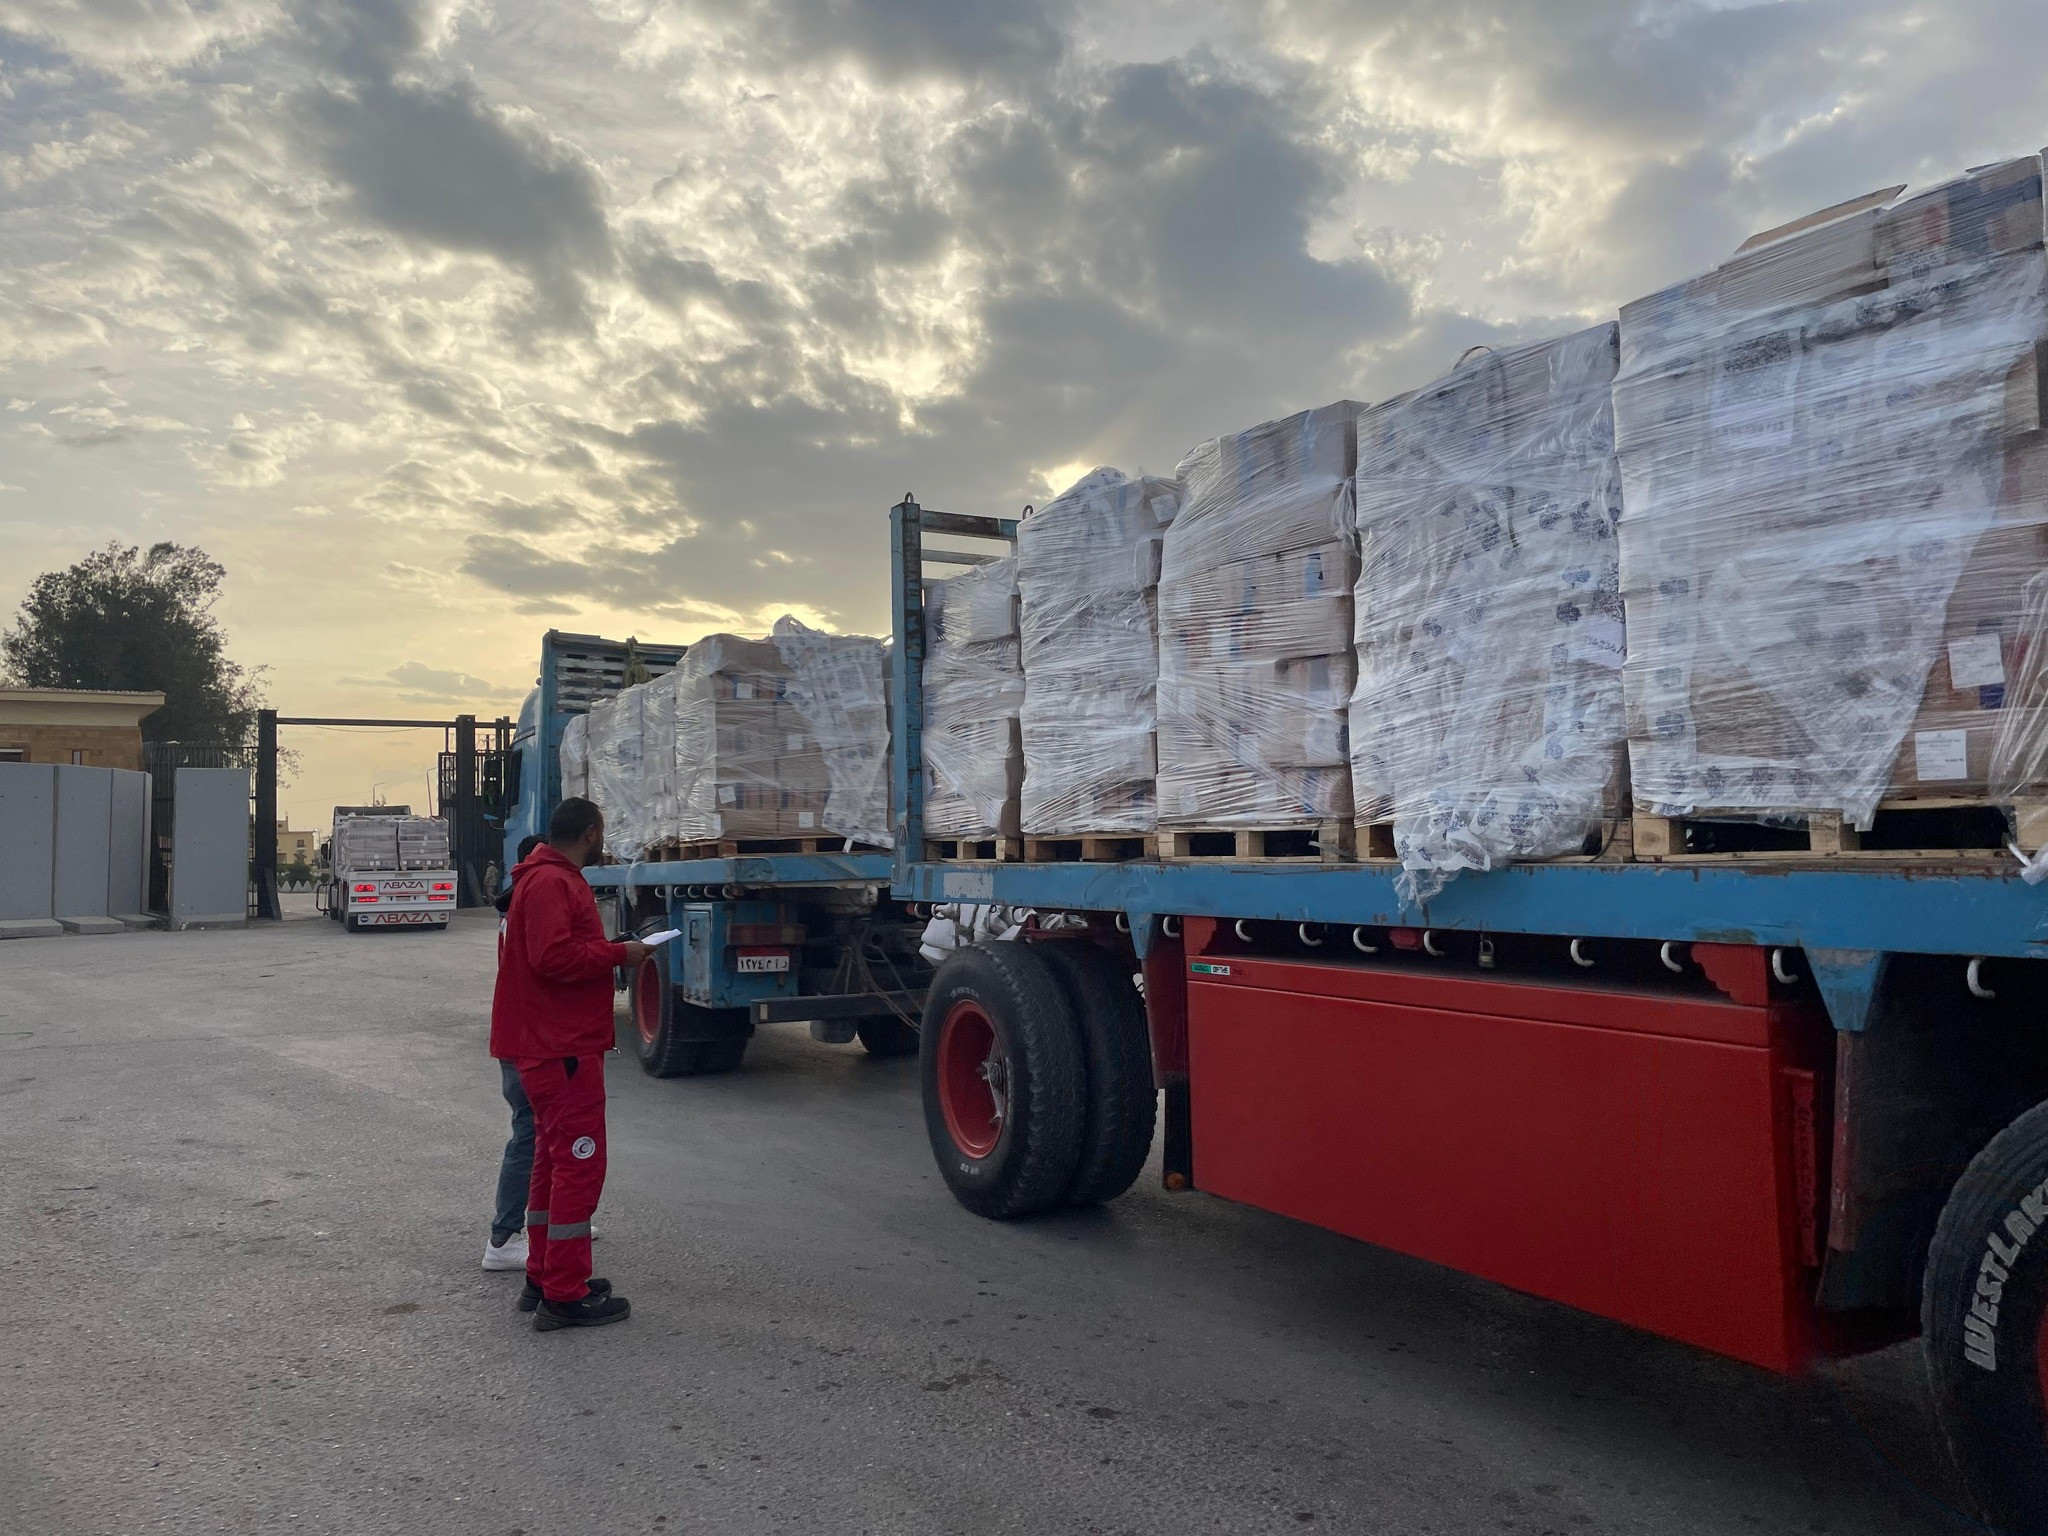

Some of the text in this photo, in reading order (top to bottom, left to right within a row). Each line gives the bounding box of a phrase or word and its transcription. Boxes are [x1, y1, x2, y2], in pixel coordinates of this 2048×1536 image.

[383, 881, 424, 889] ABAZA
[375, 912, 433, 924] ABAZA
[1964, 1178, 2048, 1371] WESTLAK
